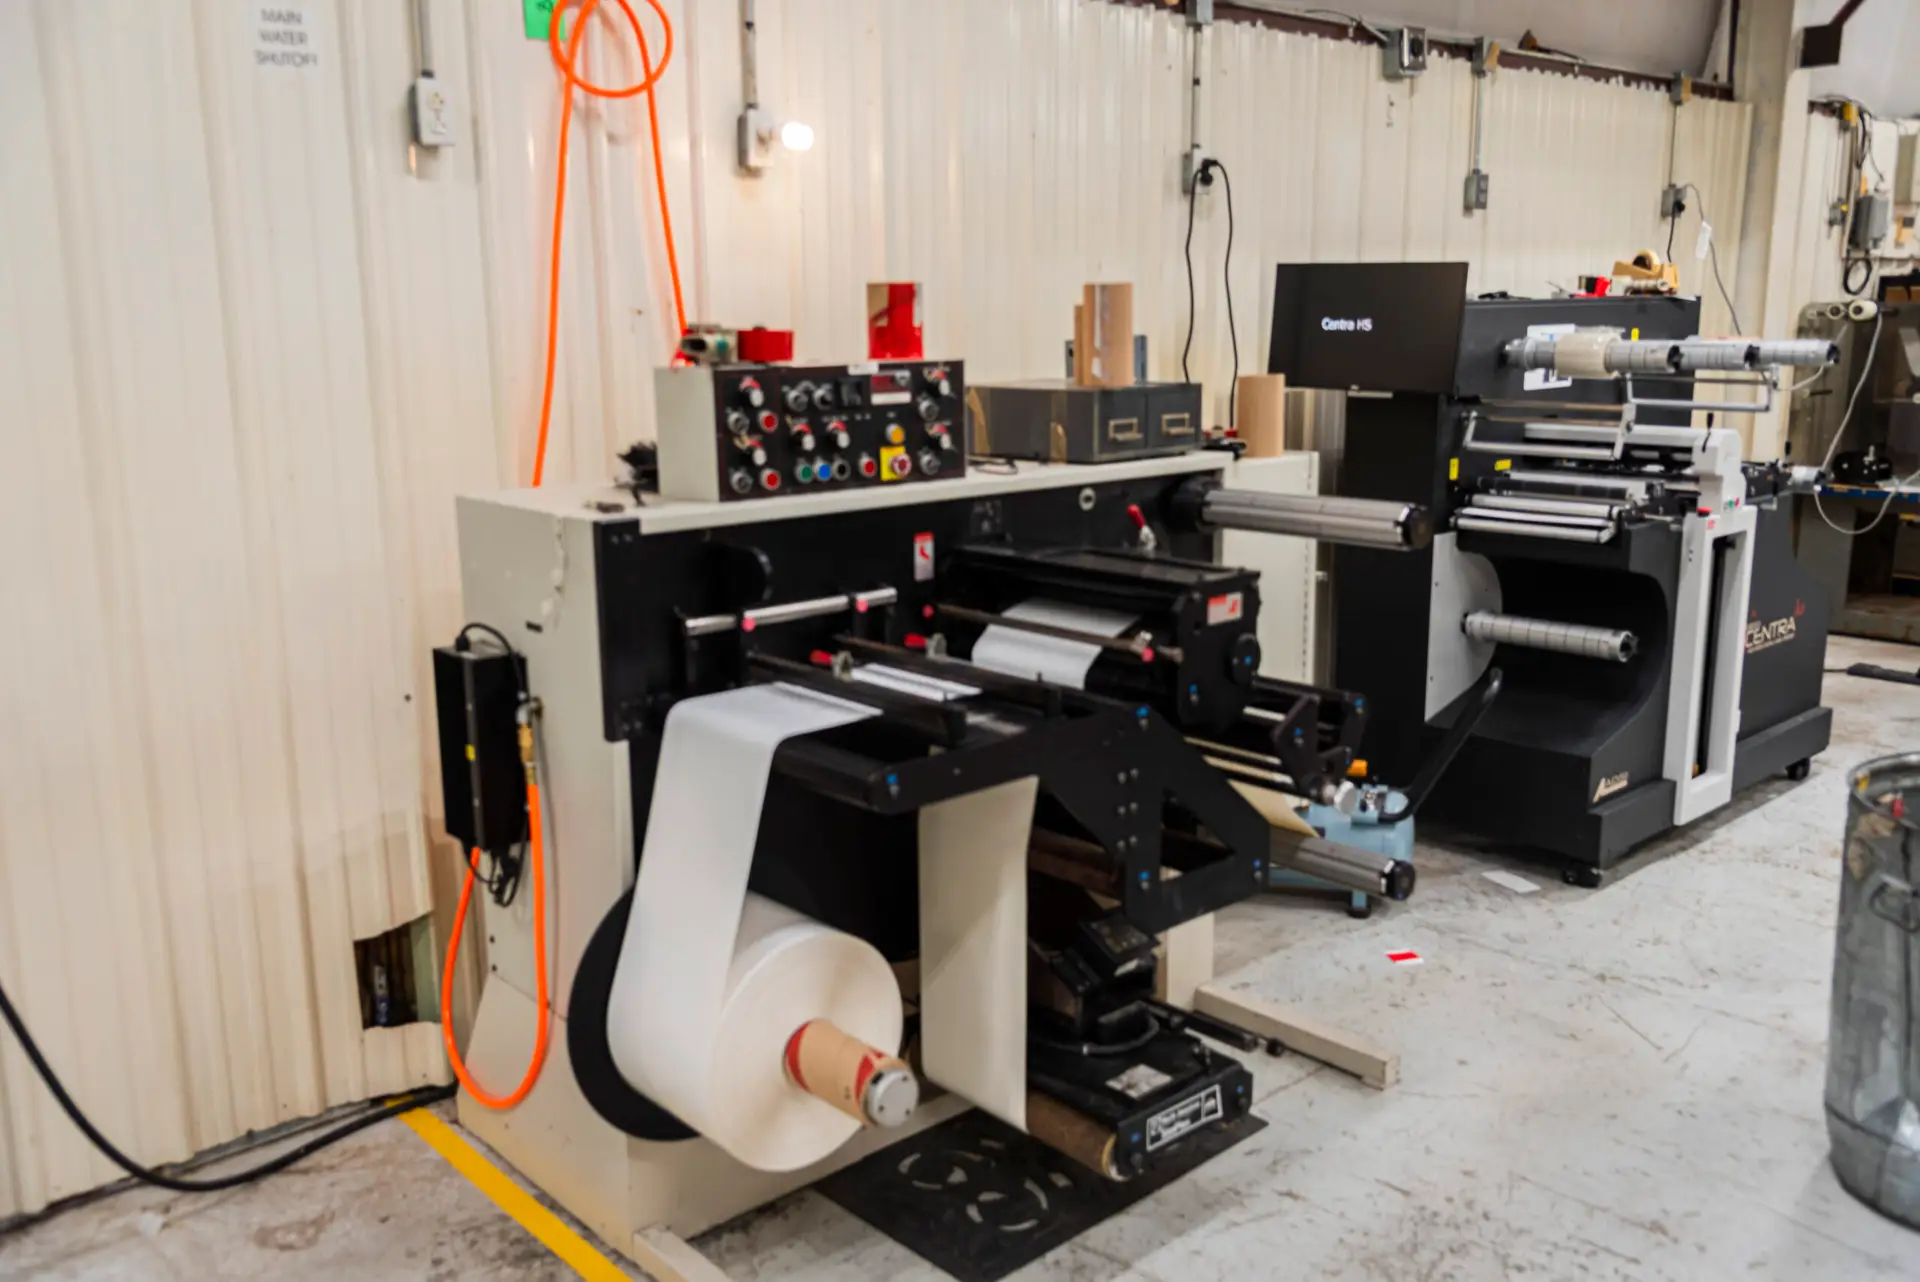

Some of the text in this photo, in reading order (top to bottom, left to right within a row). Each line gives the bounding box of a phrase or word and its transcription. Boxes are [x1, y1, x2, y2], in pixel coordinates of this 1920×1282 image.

[260, 7, 302, 25] MAIN
[258, 29, 308, 46] WATER
[1321, 316, 1373, 332] Centra HS
[1745, 616, 1796, 648] CENTRA
